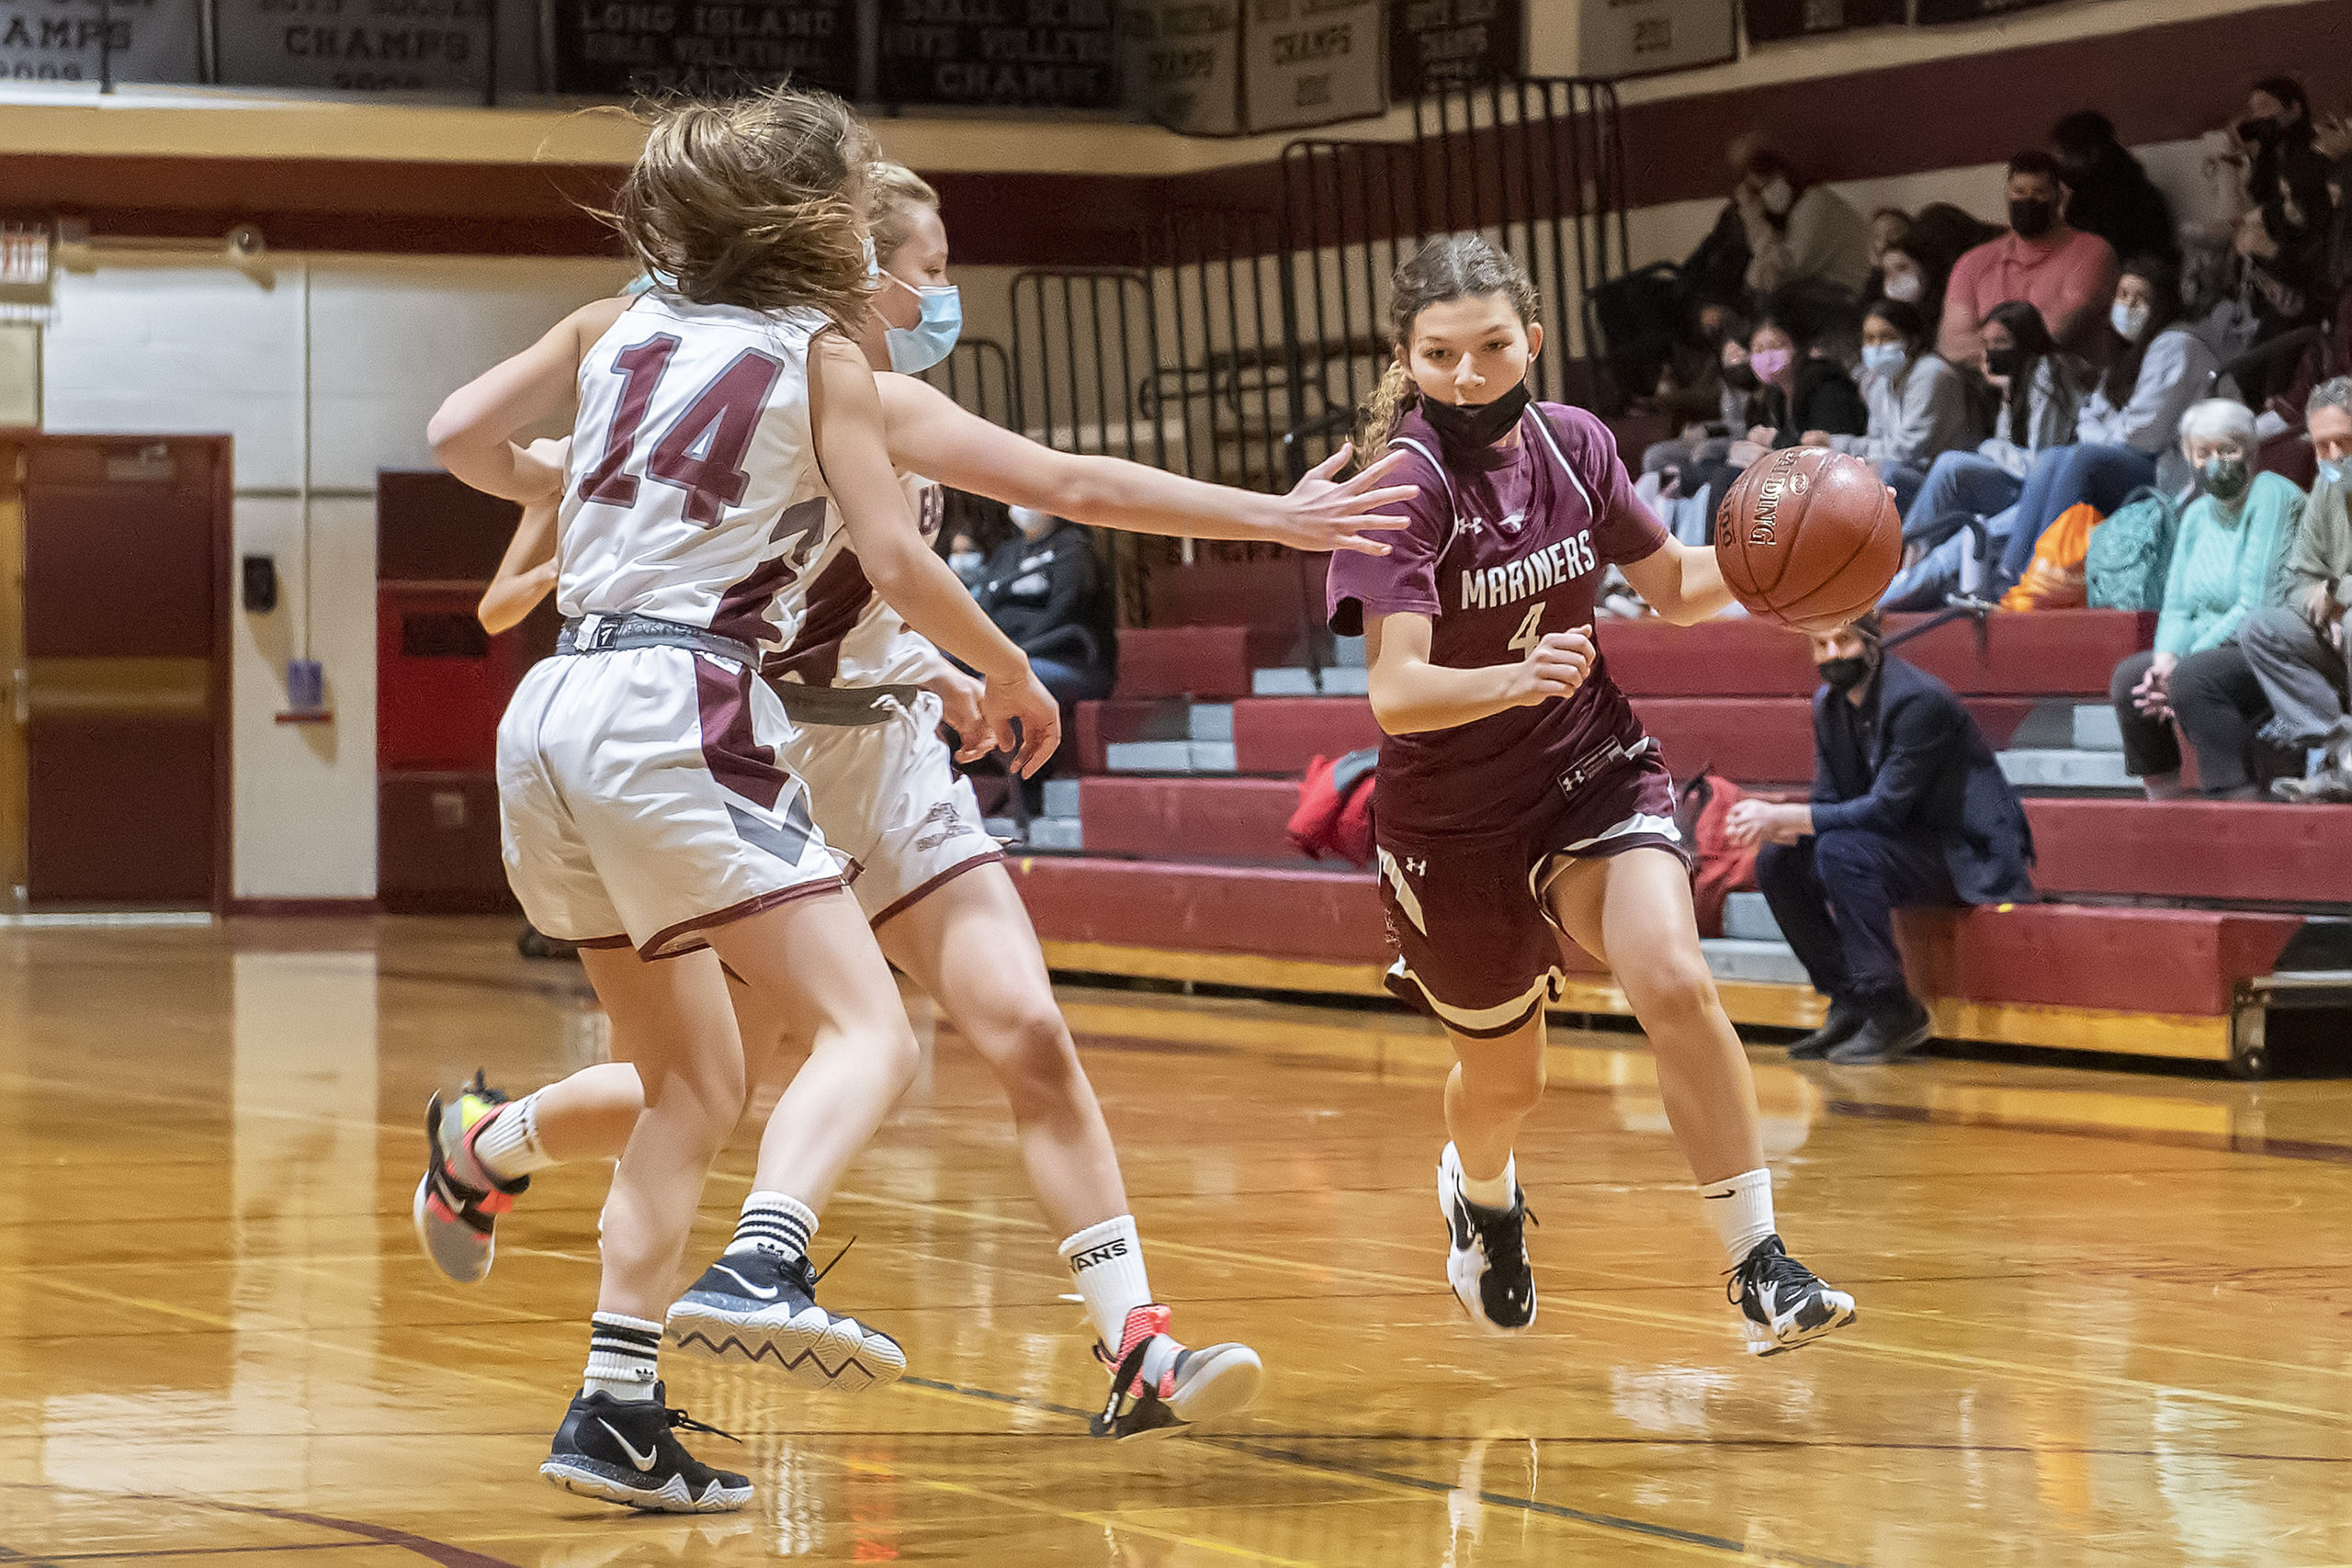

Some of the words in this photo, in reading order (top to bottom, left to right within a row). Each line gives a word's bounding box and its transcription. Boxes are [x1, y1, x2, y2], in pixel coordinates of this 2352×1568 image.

[286, 25, 470, 63] CHAMPS
[581, 4, 675, 31] LONG
[695, 6, 835, 36] ISLAND
[578, 331, 785, 529] 14
[1461, 529, 1597, 610] MARINERS
[1508, 601, 1547, 658] 4
